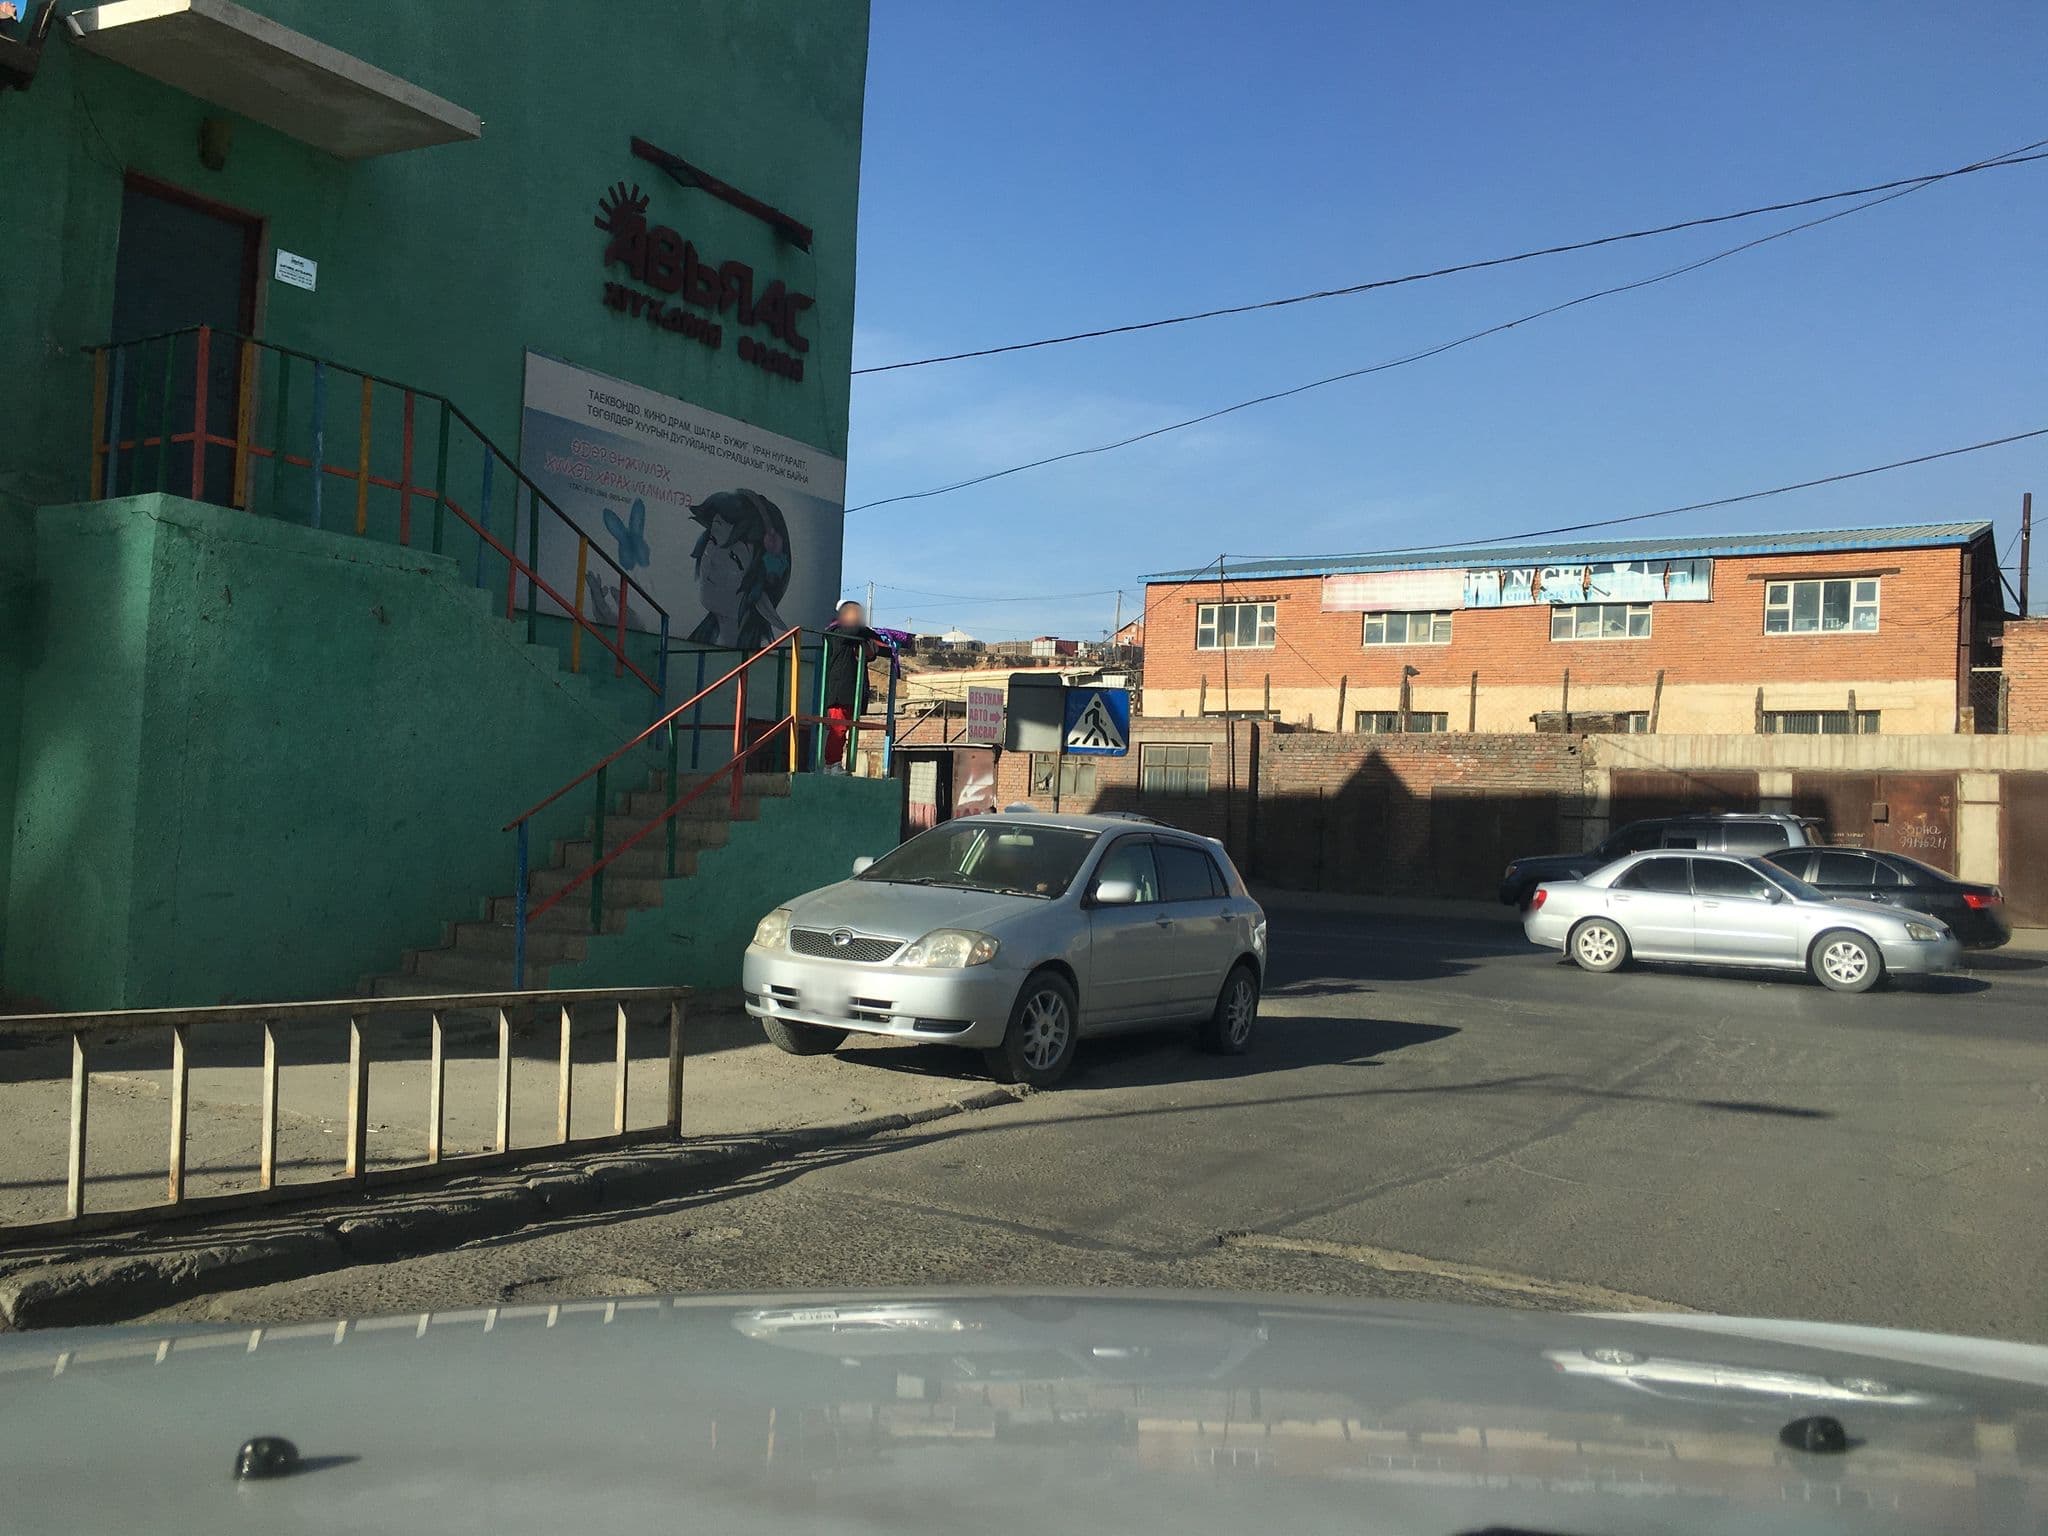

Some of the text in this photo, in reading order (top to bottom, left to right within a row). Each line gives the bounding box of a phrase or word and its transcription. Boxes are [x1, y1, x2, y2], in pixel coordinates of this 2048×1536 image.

[604, 208, 816, 353] АВЬЯАС
[643, 408, 667, 424] КИНО
[571, 439, 607, 459] ӨДӨР
[586, 404, 634, 427] ТӨГӨЛДӨР
[635, 421, 669, 440] ХУУРЫН
[669, 431, 716, 455] ДУГУЙЛАНД
[715, 446, 764, 470] СУРАЛЦАХЫГ
[786, 468, 809, 484] БАЙНА
[596, 471, 631, 492] ХАРАХ
[969, 708, 987, 721] АВТО
[969, 725, 997, 739] ЗАСВАР
